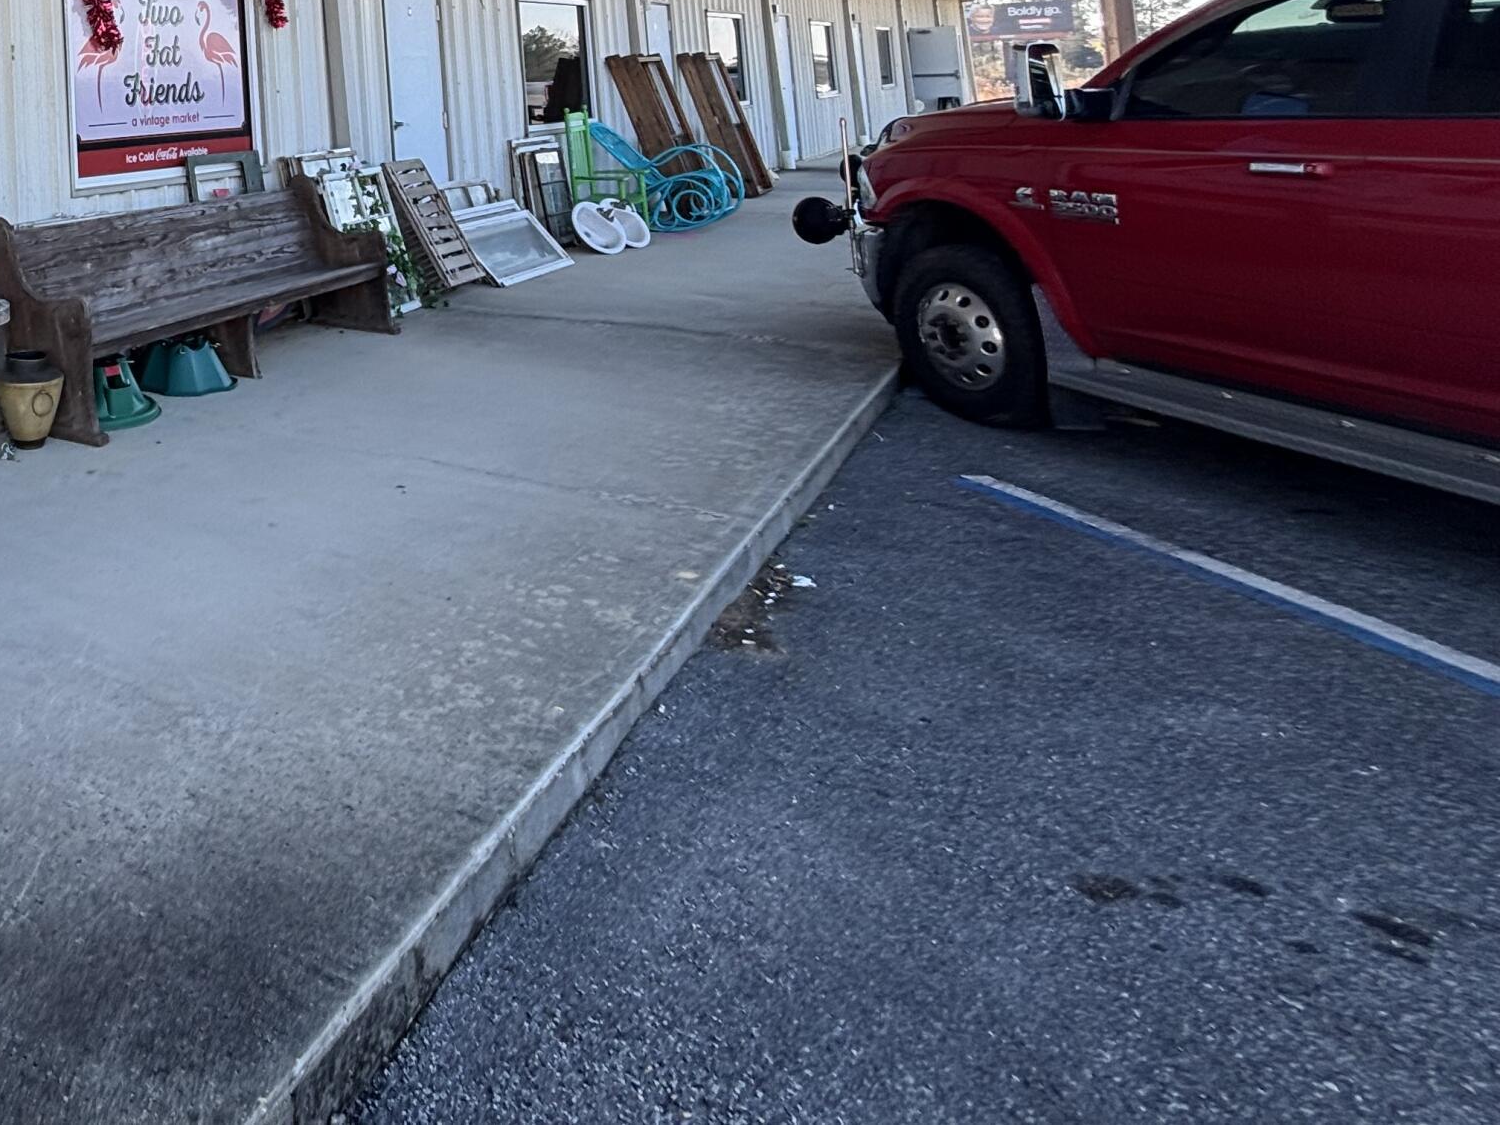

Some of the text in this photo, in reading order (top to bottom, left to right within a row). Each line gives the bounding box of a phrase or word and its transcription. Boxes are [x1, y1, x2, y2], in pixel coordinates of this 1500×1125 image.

[1007, 6, 1043, 17] Boldly
[144, 35, 182, 67] Fat
[123, 72, 205, 107] Friends
[132, 112, 200, 127] a vintage market
[125, 155, 137, 163] Ice
[138, 152, 155, 162] Cold
[178, 147, 208, 157] Available
